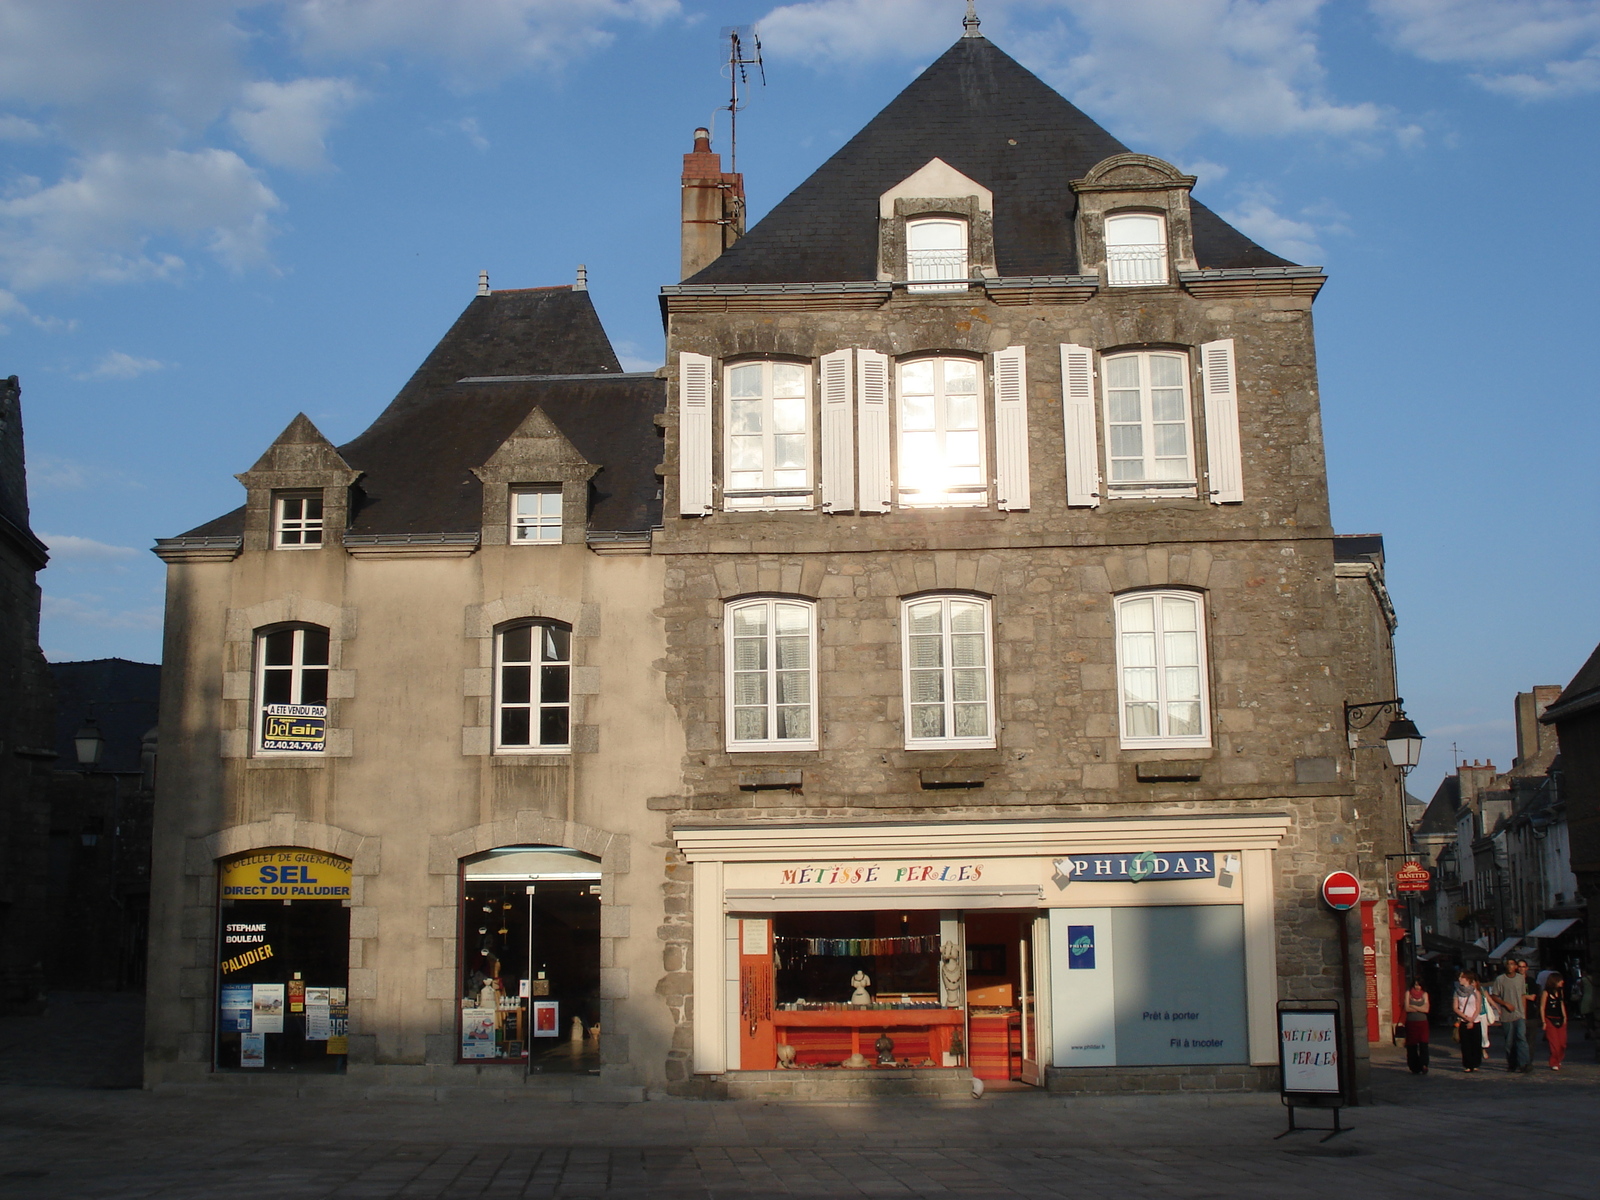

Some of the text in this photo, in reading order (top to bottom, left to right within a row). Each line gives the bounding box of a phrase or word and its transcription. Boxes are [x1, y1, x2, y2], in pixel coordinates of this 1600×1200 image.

[288, 706, 310, 715] VENDU
[311, 707, 324, 716] PAR
[292, 724, 323, 735] air
[264, 741, 324, 750] 02.40.24.79.49
[278, 853, 291, 862] DE
[1074, 857, 1211, 876] PHILDAR
[259, 865, 318, 884] SEL
[894, 864, 984, 882] PERLES
[224, 886, 349, 896] DIRECT DU PALUDIER
[226, 923, 266, 932] STEPHANE
[225, 935, 264, 943] BOULEAU
[1142, 1011, 1199, 1021] Prêt à porter
[1170, 1039, 1224, 1048] Fil à tricoter
[1292, 1051, 1338, 1066] PERLES
